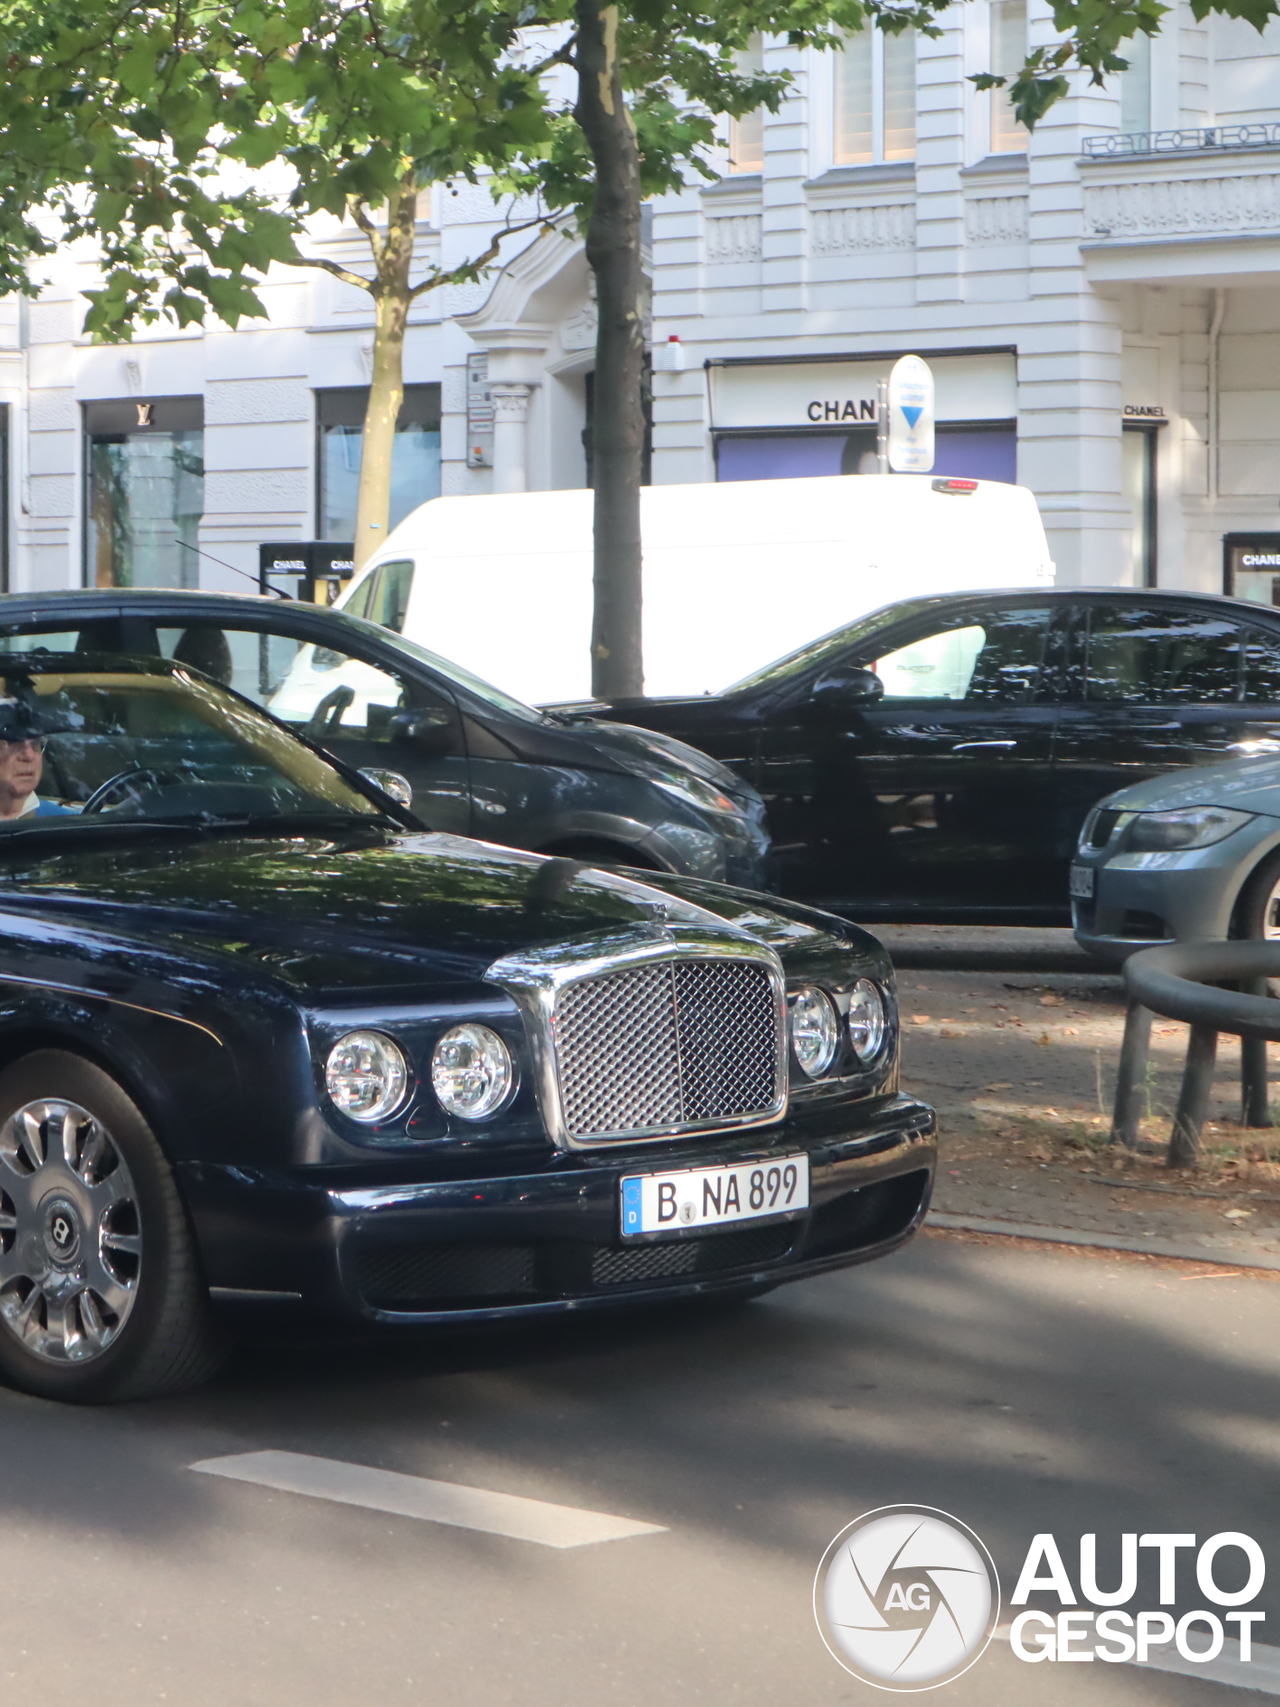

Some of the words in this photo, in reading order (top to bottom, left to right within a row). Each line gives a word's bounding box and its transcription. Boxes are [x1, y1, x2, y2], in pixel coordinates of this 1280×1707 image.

[807, 399, 875, 422] CHAN
[1123, 404, 1167, 417] CHANEL
[273, 560, 307, 570] CHANEL
[1242, 554, 1280, 566] CHANE
[658, 1182, 678, 1223] B
[702, 1173, 741, 1217] NA
[749, 1164, 798, 1210] 899
[628, 1211, 637, 1224] D
